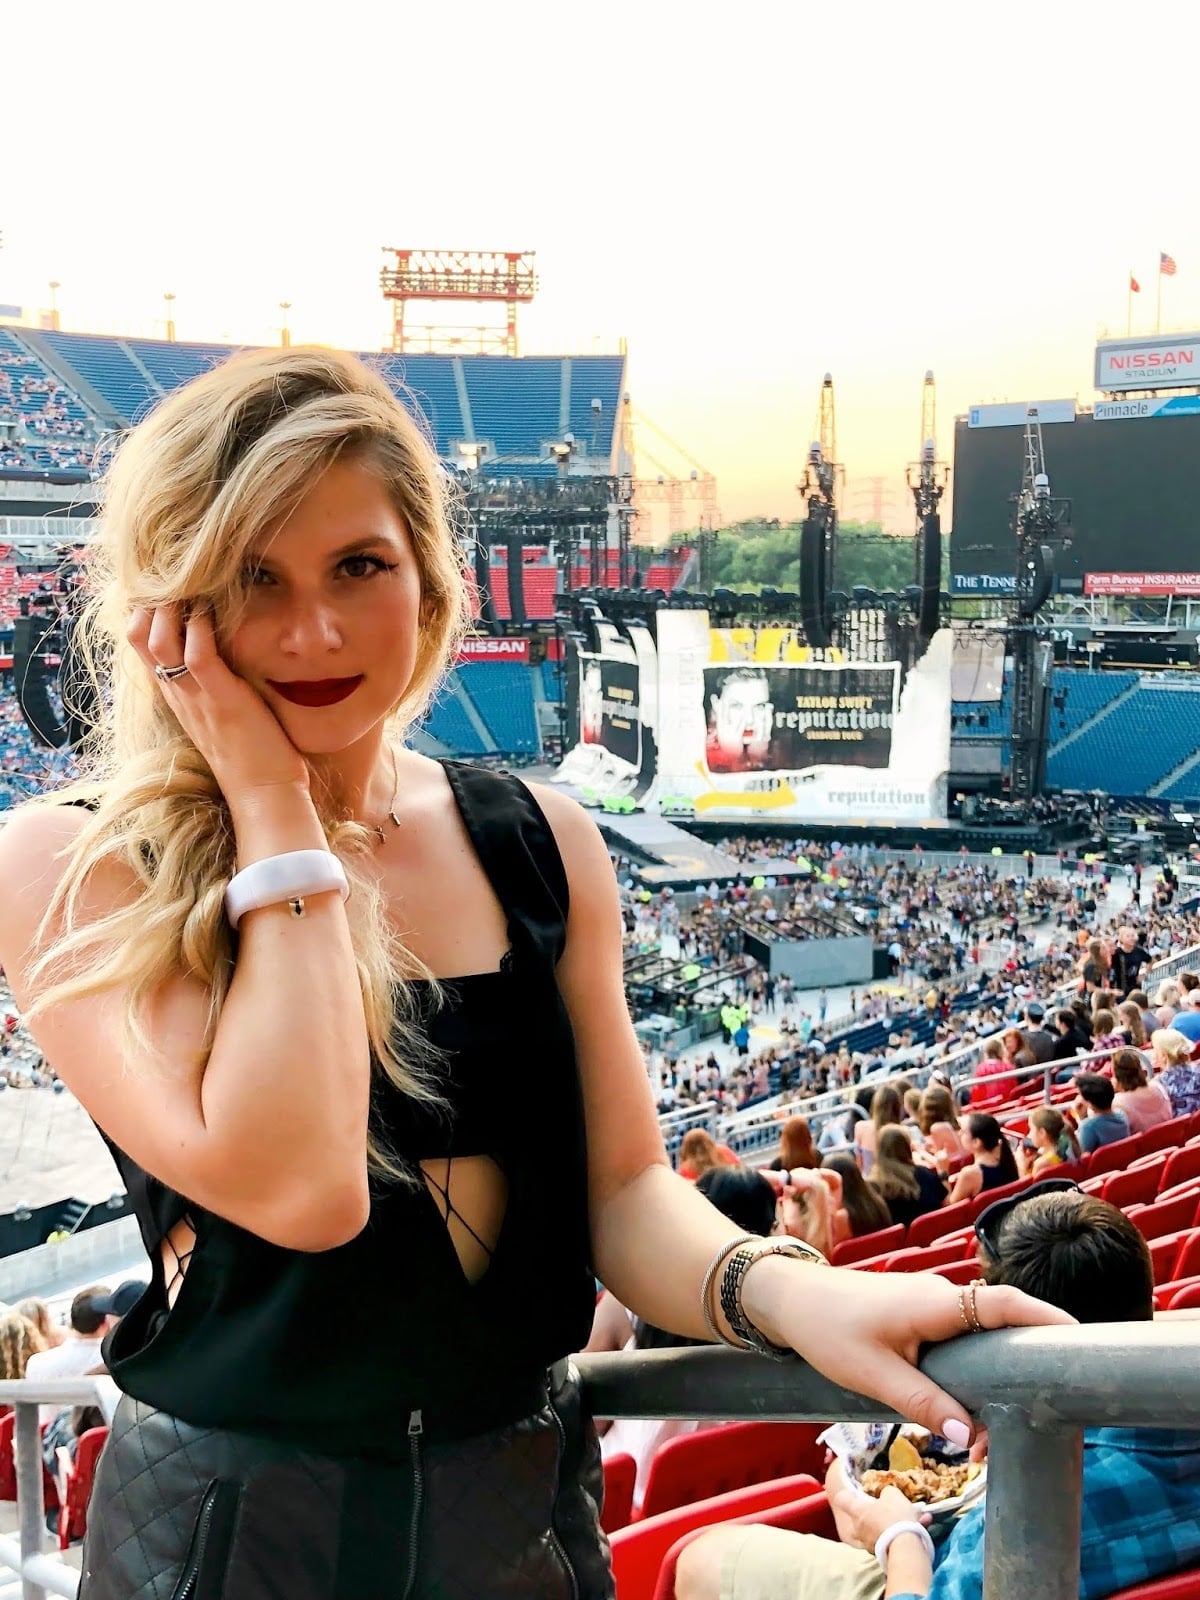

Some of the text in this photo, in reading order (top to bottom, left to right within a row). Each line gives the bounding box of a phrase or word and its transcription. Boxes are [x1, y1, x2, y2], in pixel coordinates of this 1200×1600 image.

[1109, 350, 1195, 369] NISSAN
[1125, 367, 1177, 378] STADIUM
[1095, 402, 1149, 417] Pinnacle
[954, 574, 979, 588] THE
[1144, 574, 1200, 585] INSURANCE
[459, 641, 525, 653] NISSAN
[775, 708, 894, 734] reputation
[828, 788, 926, 807] reputation
